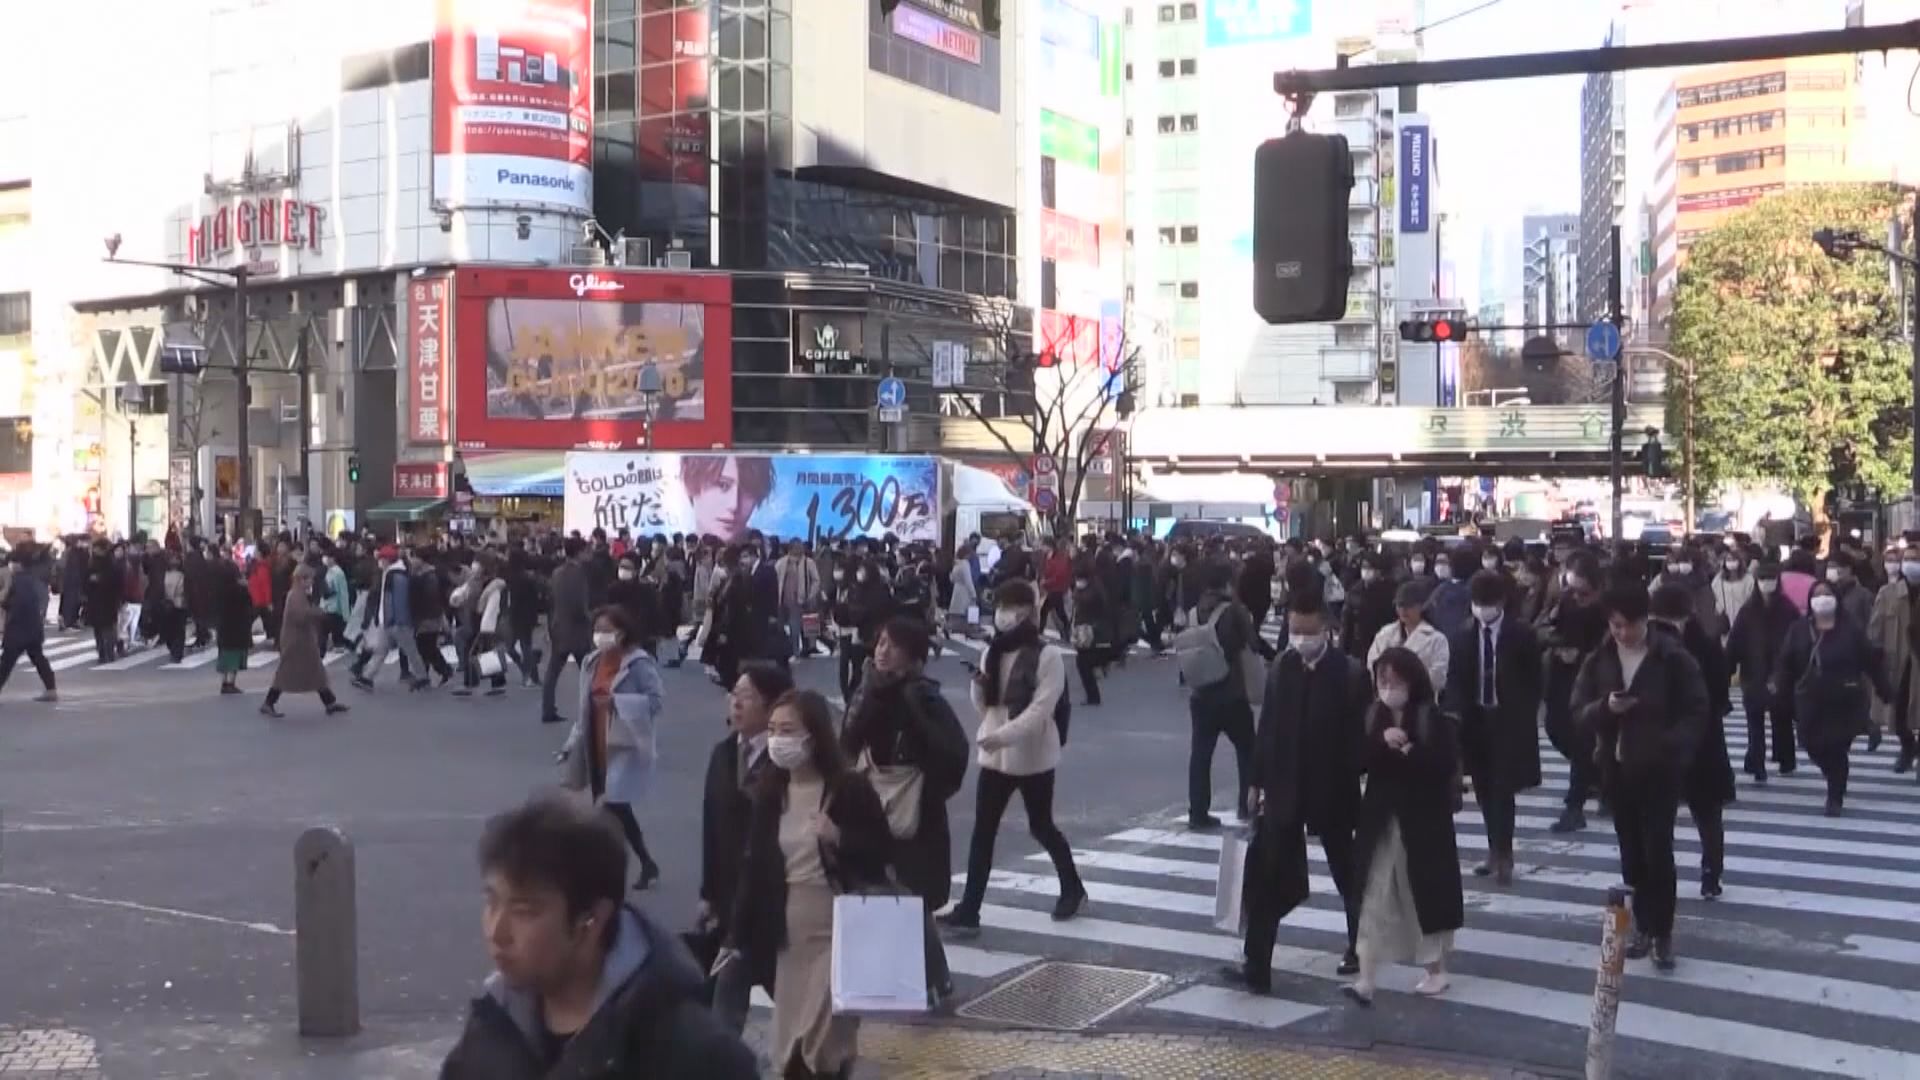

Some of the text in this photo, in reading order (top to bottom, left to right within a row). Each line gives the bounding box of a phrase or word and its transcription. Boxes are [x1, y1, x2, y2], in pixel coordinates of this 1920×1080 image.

[1412, 133, 1422, 176] MIZUHO
[497, 168, 576, 191] Panasonic
[188, 198, 327, 264] MAGNET
[569, 273, 625, 297] Glico
[418, 304, 440, 436] 天津甘栗
[805, 349, 851, 361] COFFEE
